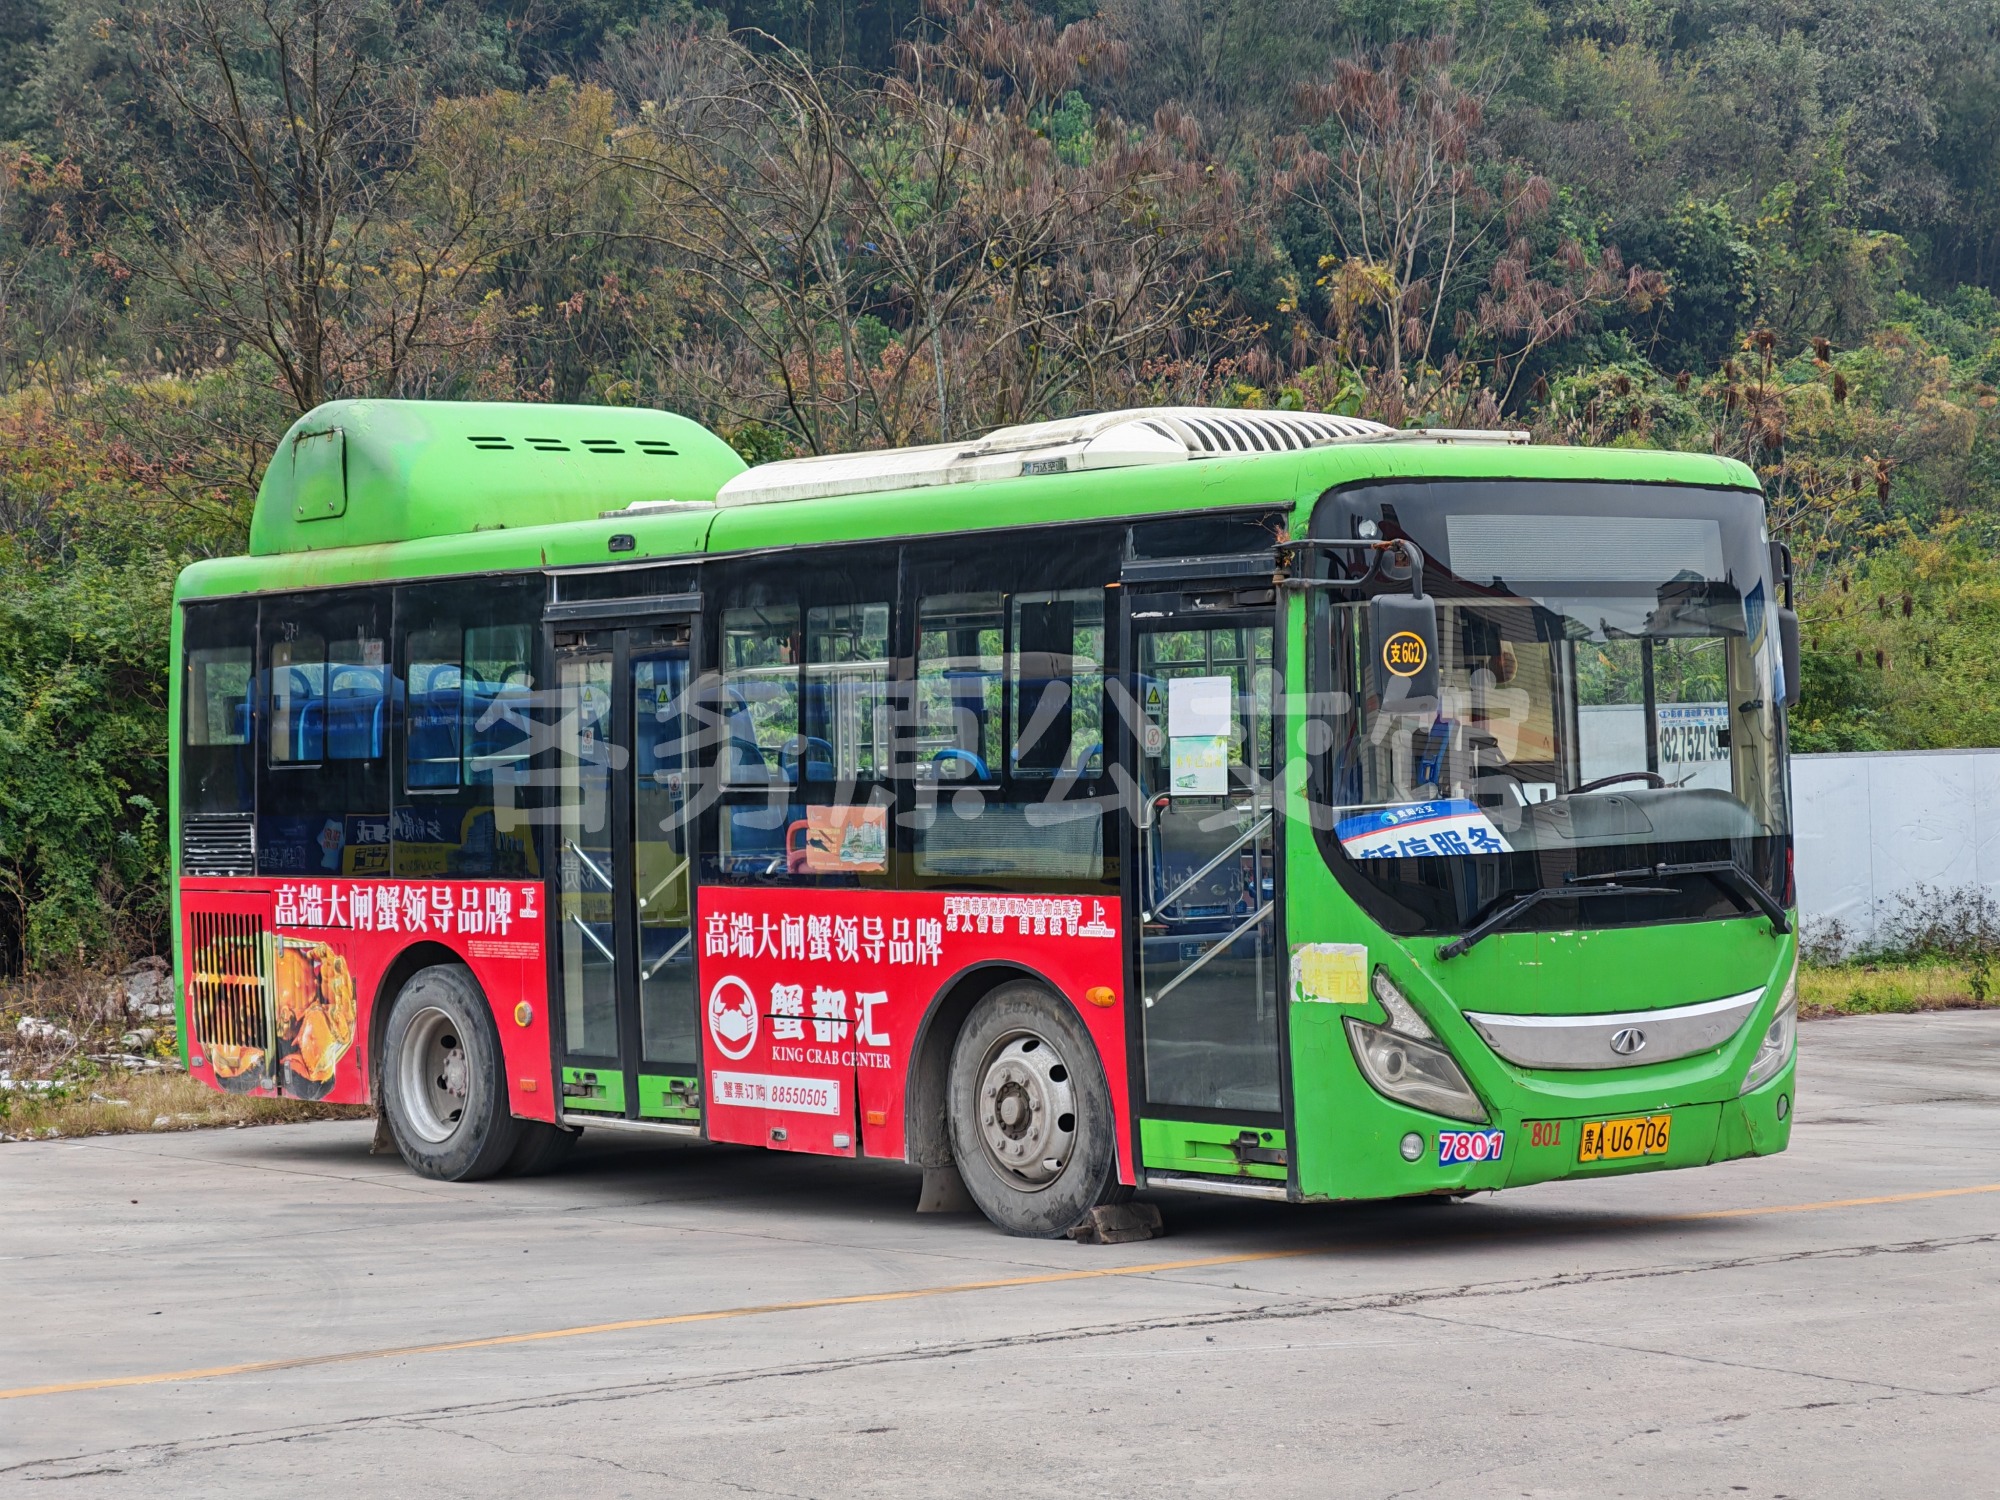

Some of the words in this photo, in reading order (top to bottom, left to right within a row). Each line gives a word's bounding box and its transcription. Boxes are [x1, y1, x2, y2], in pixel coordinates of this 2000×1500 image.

[274, 884, 513, 936] 高端大闸蟹领导品牌
[522, 887, 535, 910] 下
[943, 897, 1082, 918] 严禁携带易燃易爆及危险物品乘车
[946, 915, 1004, 933] 无人售票
[1019, 916, 1079, 936] 自觉投币
[1088, 900, 1105, 928] 上
[705, 911, 943, 967] 高端大闸蟹领导品牌
[771, 982, 890, 1046] 蟹都汇
[772, 1046, 804, 1063] KING
[806, 1048, 839, 1065] CRAB
[842, 1051, 891, 1069] CENTER
[723, 1081, 766, 1102] 蟹票订购
[771, 1085, 828, 1108] 88550505
[1439, 1132, 1504, 1161] 7801
